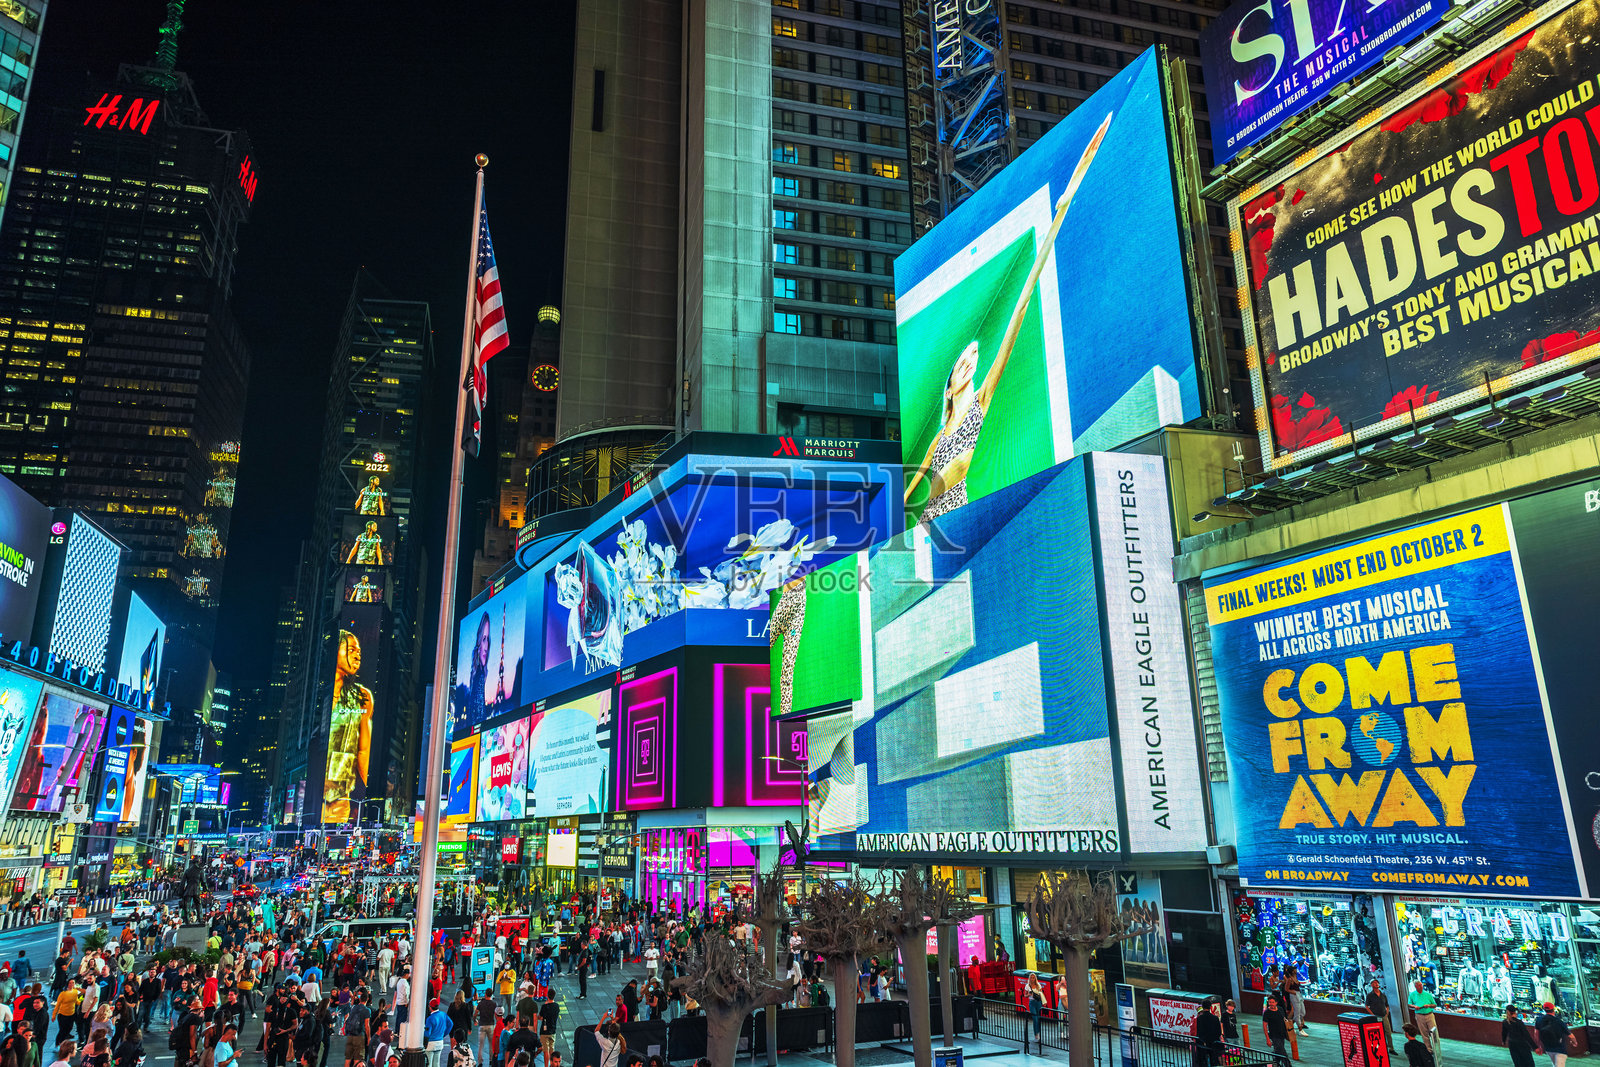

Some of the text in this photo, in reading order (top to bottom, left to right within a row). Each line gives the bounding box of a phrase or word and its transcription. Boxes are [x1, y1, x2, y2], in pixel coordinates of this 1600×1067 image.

[1236, 1, 1432, 141] BROOKS ATKINSON THEATRE 256 W 47TH ST SIXONBROADWAY.COM
[1275, 26, 1369, 99] THE MUSICAL
[84, 93, 160, 135] H&M
[238, 155, 257, 202] H&M
[1305, 79, 1594, 249] COME SEE HOW THE WORLD COULD
[1267, 104, 1600, 350] HADESTO
[1279, 309, 1389, 373] BROADWAY'S
[1455, 261, 1498, 296] AND
[1502, 211, 1600, 270] GRAMM
[1382, 309, 1450, 357] BEST
[805, 438, 860, 449] MARRIOTT
[805, 448, 854, 458] MARQUIS
[365, 463, 389, 472] 2022
[50, 536, 64, 544] LG
[24, 557, 34, 574] IN
[1218, 523, 1484, 614] FINAL WEEKS! MUST END OCTOBER 2
[1254, 583, 1449, 642] WINNER! BEST MUSICAL
[1259, 610, 1452, 662] ALL ACROSS NORTH AMERICA
[1118, 469, 1171, 831] AMERICAN EAGLE OUTFITTERS
[1263, 643, 1461, 718] COME
[1279, 764, 1477, 829] AWAY
[604, 856, 628, 866] SEPHORA
[857, 830, 1119, 852] AMERICAN EAGLE OUTFITTERS
[1296, 833, 1469, 845] TRUE STORY. HIT MUSICAL.
[1296, 855, 1322, 863] Gerald
[1324, 855, 1372, 864] Schoenfeld
[1374, 855, 1412, 865] Theatre,
[1415, 856, 1432, 865] 236
[1435, 856, 1449, 865] W.
[1476, 856, 1491, 866] St.
[1265, 870, 1349, 881] ON BROADWAY
[1441, 906, 1571, 942] GRAND
